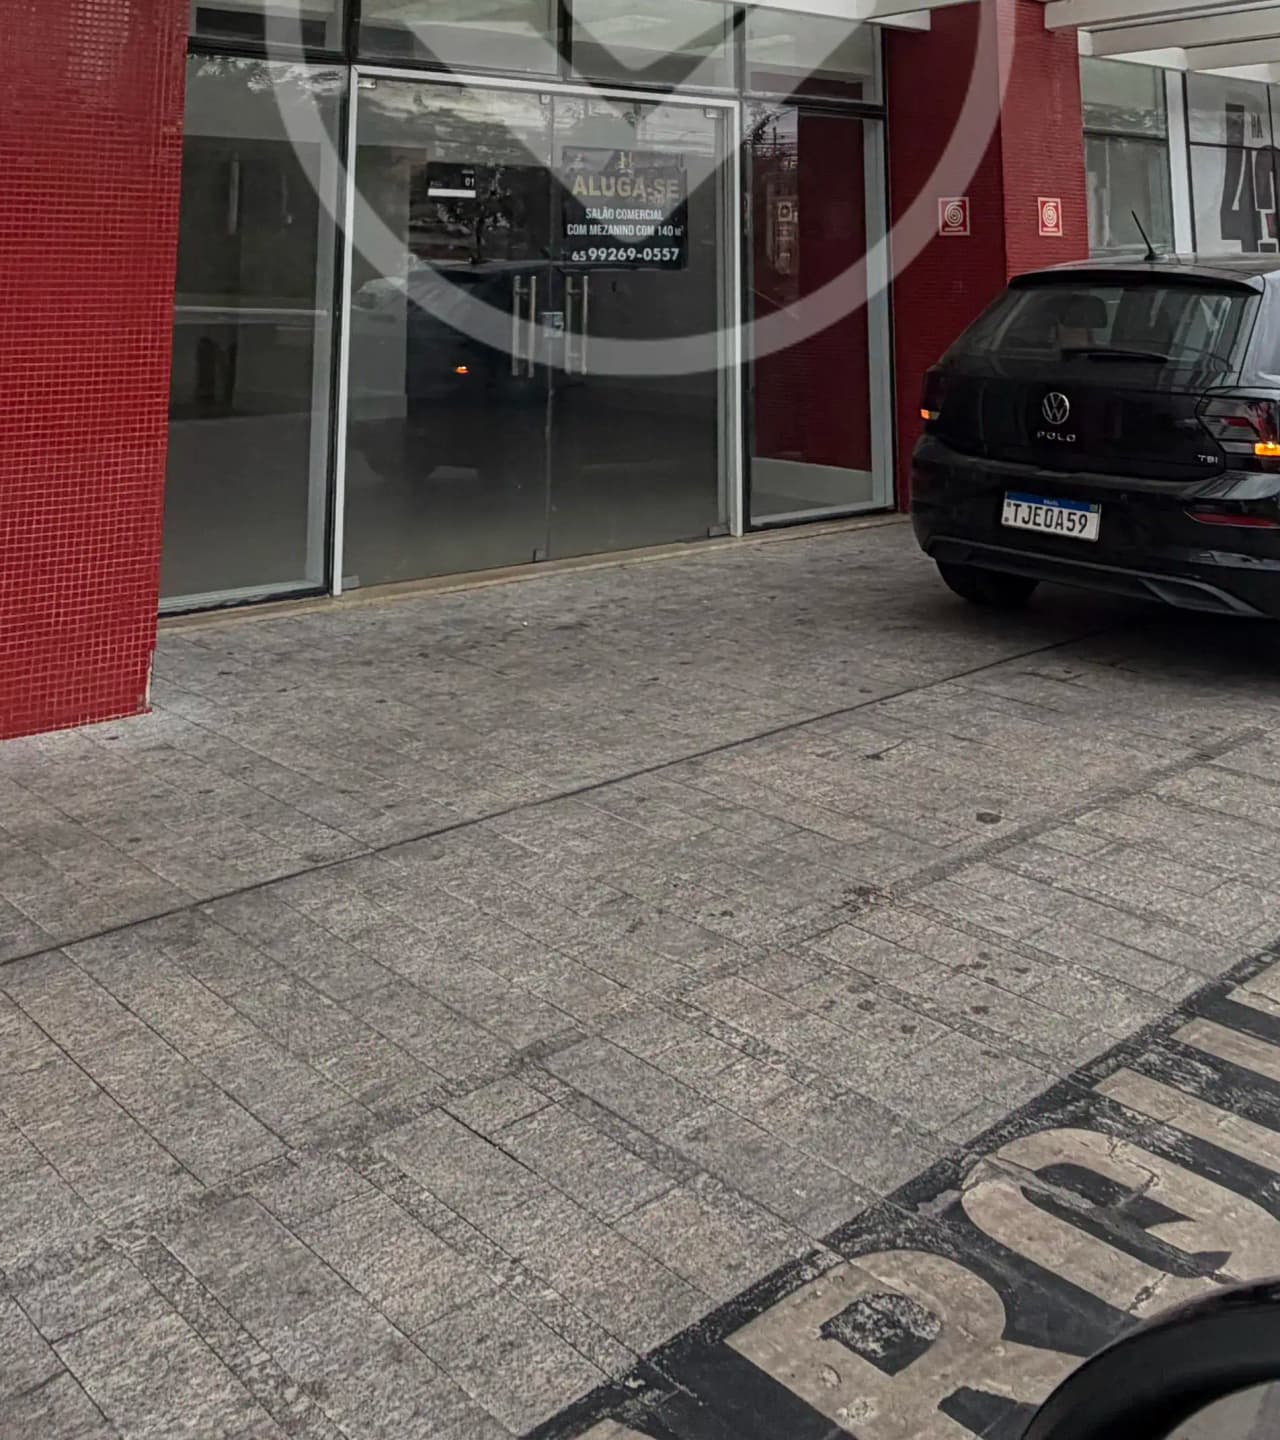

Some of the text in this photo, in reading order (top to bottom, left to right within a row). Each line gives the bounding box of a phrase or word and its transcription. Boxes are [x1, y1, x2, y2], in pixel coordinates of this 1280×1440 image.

[571, 175, 680, 201] ALUGA-SE
[585, 205, 664, 221] SALÃO COMERCIAL
[567, 224, 587, 236] COM
[589, 224, 635, 236] MEZANINO
[636, 225, 655, 236] COM
[657, 225, 673, 237] 140
[571, 247, 680, 261] 65 99269-0557
[1036, 431, 1076, 442] POLO
